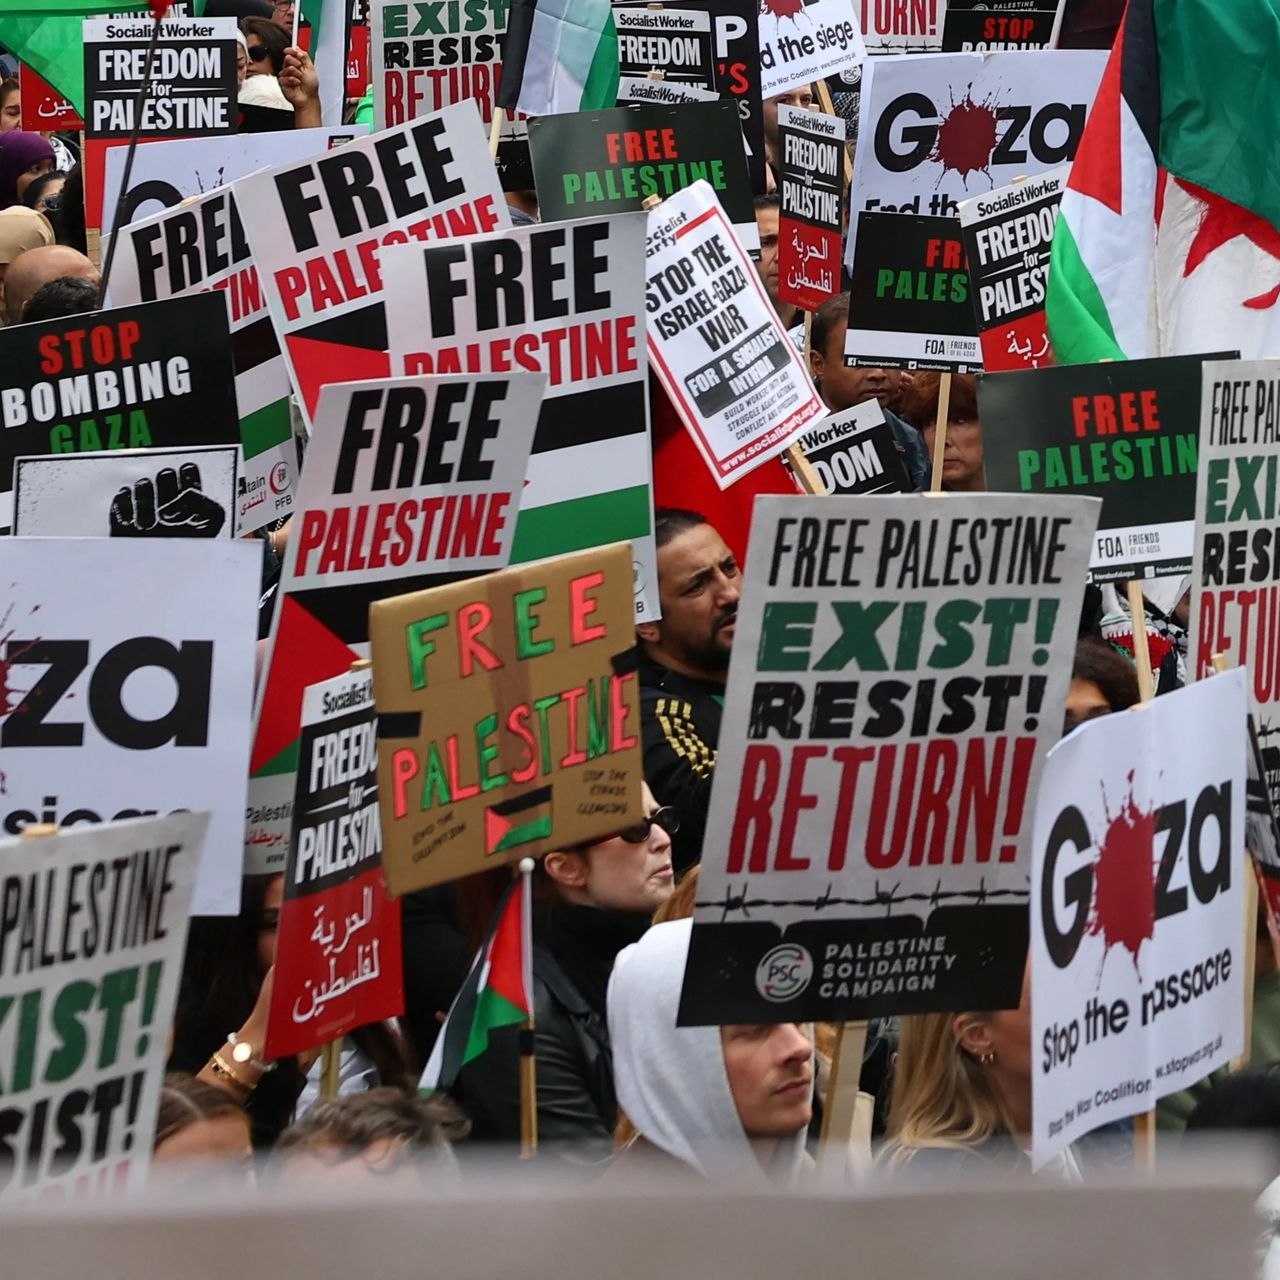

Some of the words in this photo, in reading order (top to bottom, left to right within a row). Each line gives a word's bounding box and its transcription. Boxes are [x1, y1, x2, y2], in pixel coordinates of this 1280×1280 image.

[98, 47, 221, 81] FREEDOM
[106, 24, 160, 40] Socialist
[163, 23, 215, 39] Worker
[93, 96, 230, 132] PALESTINE
[151, 81, 172, 96] for
[424, 222, 611, 338] FREE
[39, 321, 141, 375] STOP
[1, 356, 193, 428] BOMBING
[332, 381, 510, 495] FREE
[294, 492, 511, 578] PALESTINE
[768, 517, 869, 588] FREE
[875, 518, 1073, 588] PALESTINE
[405, 571, 607, 690] FREE
[756, 598, 1060, 672] EXIST!
[746, 676, 1047, 739] RESIST!
[392, 672, 639, 820] PALESTINE
[726, 737, 1038, 874] RETURN!
[310, 887, 375, 952] الحرية
[825, 936, 946, 959] PALESTINE
[292, 940, 381, 1023] لفلسطين
[767, 962, 801, 982] PSC
[819, 974, 936, 998] CAMPAIGN
[822, 954, 957, 978] SOLIDARITY
[1042, 1027, 1079, 1075] Stop
[1083, 996, 1129, 1048] the
